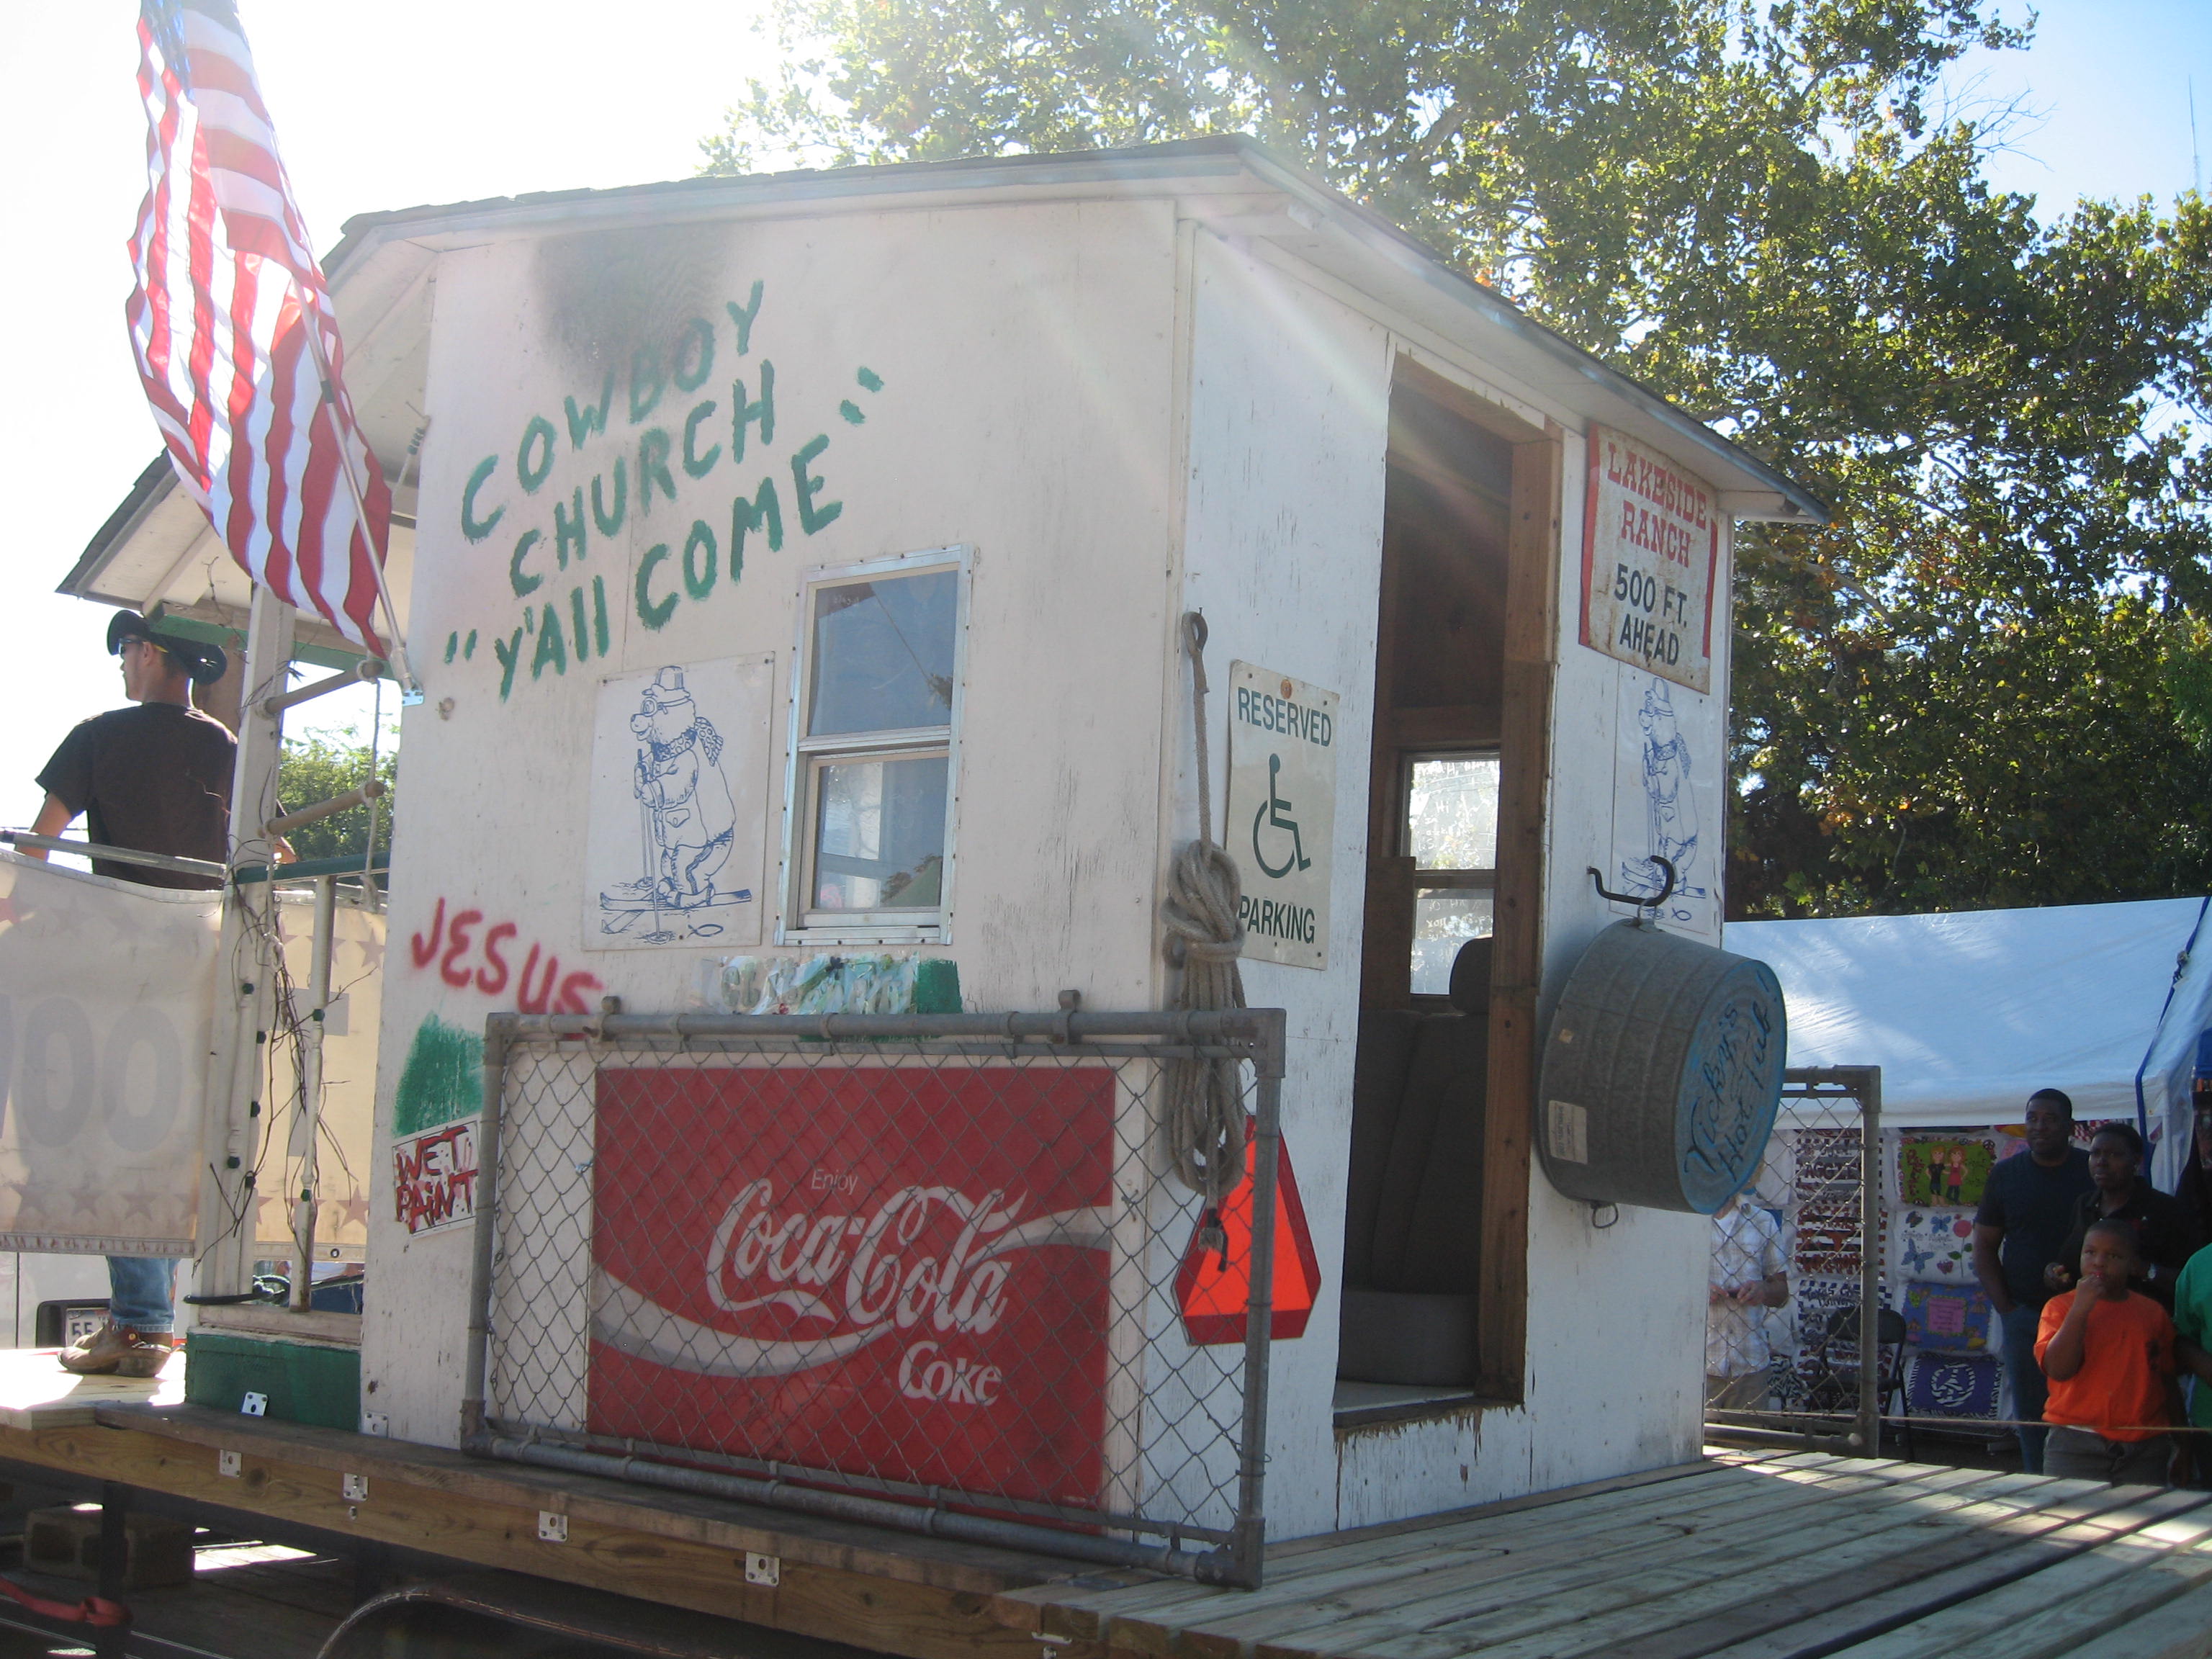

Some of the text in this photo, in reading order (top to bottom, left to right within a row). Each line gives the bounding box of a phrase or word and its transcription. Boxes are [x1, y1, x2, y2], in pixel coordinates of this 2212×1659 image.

[461, 281, 764, 544] COWBOY
[510, 359, 774, 598] CHURCH
[1607, 441, 1707, 530] LAKESIDE
[1621, 500, 1690, 567] RANCH
[1614, 563, 1687, 628] 500 FT.
[1619, 613, 1679, 666] AHEAD
[1238, 686, 1331, 747] RESERVED
[1238, 896, 1315, 944] PARKING
[411, 896, 603, 1041] JESUS
[397, 1126, 469, 1184] WET
[811, 1169, 858, 1195] Enjoy
[706, 1178, 1028, 1334] Coca-Cola
[899, 1341, 1002, 1406] Coke
